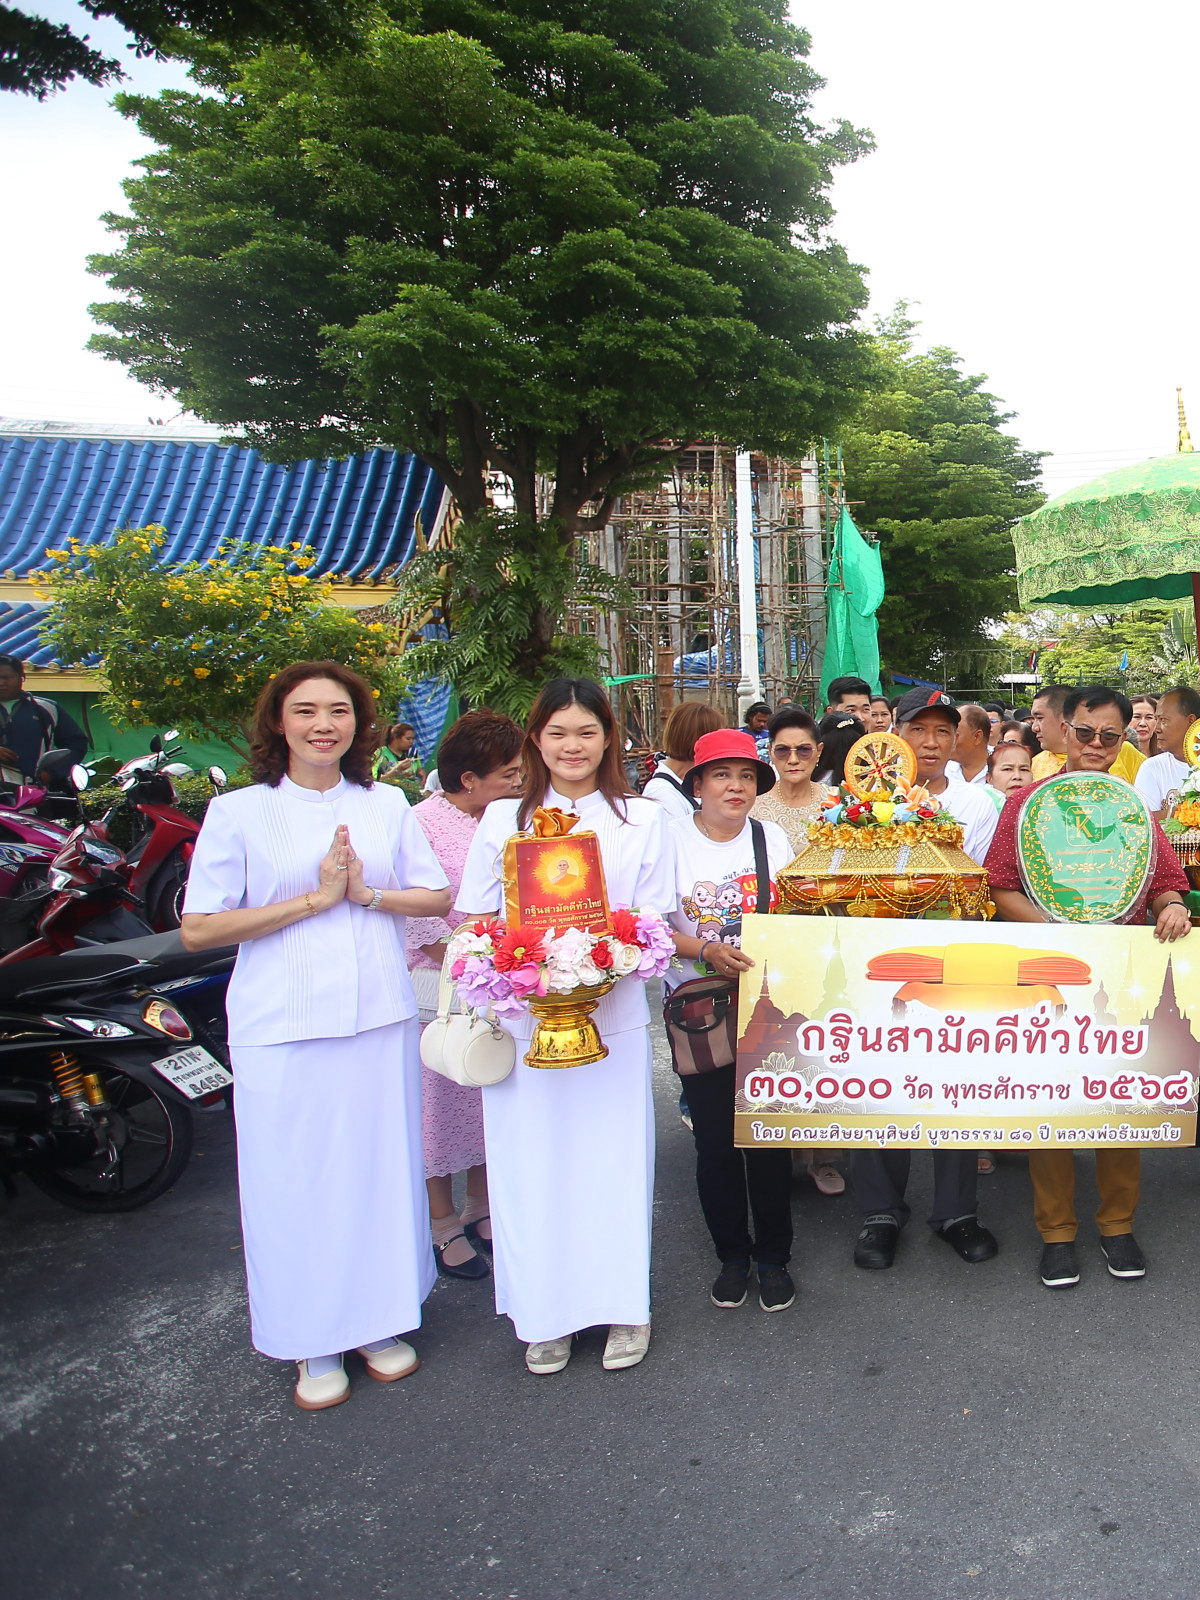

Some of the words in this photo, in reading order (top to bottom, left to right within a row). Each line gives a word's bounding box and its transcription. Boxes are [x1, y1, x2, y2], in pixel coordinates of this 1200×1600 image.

[525, 898, 602, 917] กฐินสามัคคีทั่วไทย
[802, 1005, 1144, 1063] กฐินสามัคคีทั่วไทย
[188, 1073, 228, 1095] 8456
[750, 1075, 892, 1103] ๓๐,๐๐๐
[903, 1075, 933, 1100] วัด
[942, 1076, 1071, 1109] พุทธศักราช
[1082, 1074, 1188, 1100] ๒๕๖๘
[753, 1123, 784, 1140] โดย
[791, 1124, 921, 1145] คณะศิษยานุศิษย์
[927, 1128, 1003, 1145] บูชาธรรม
[1010, 1129, 1033, 1141] ๘๑
[1040, 1124, 1050, 1140] ปี
[1057, 1124, 1181, 1140] หลวงพ่อธัมมชโย
